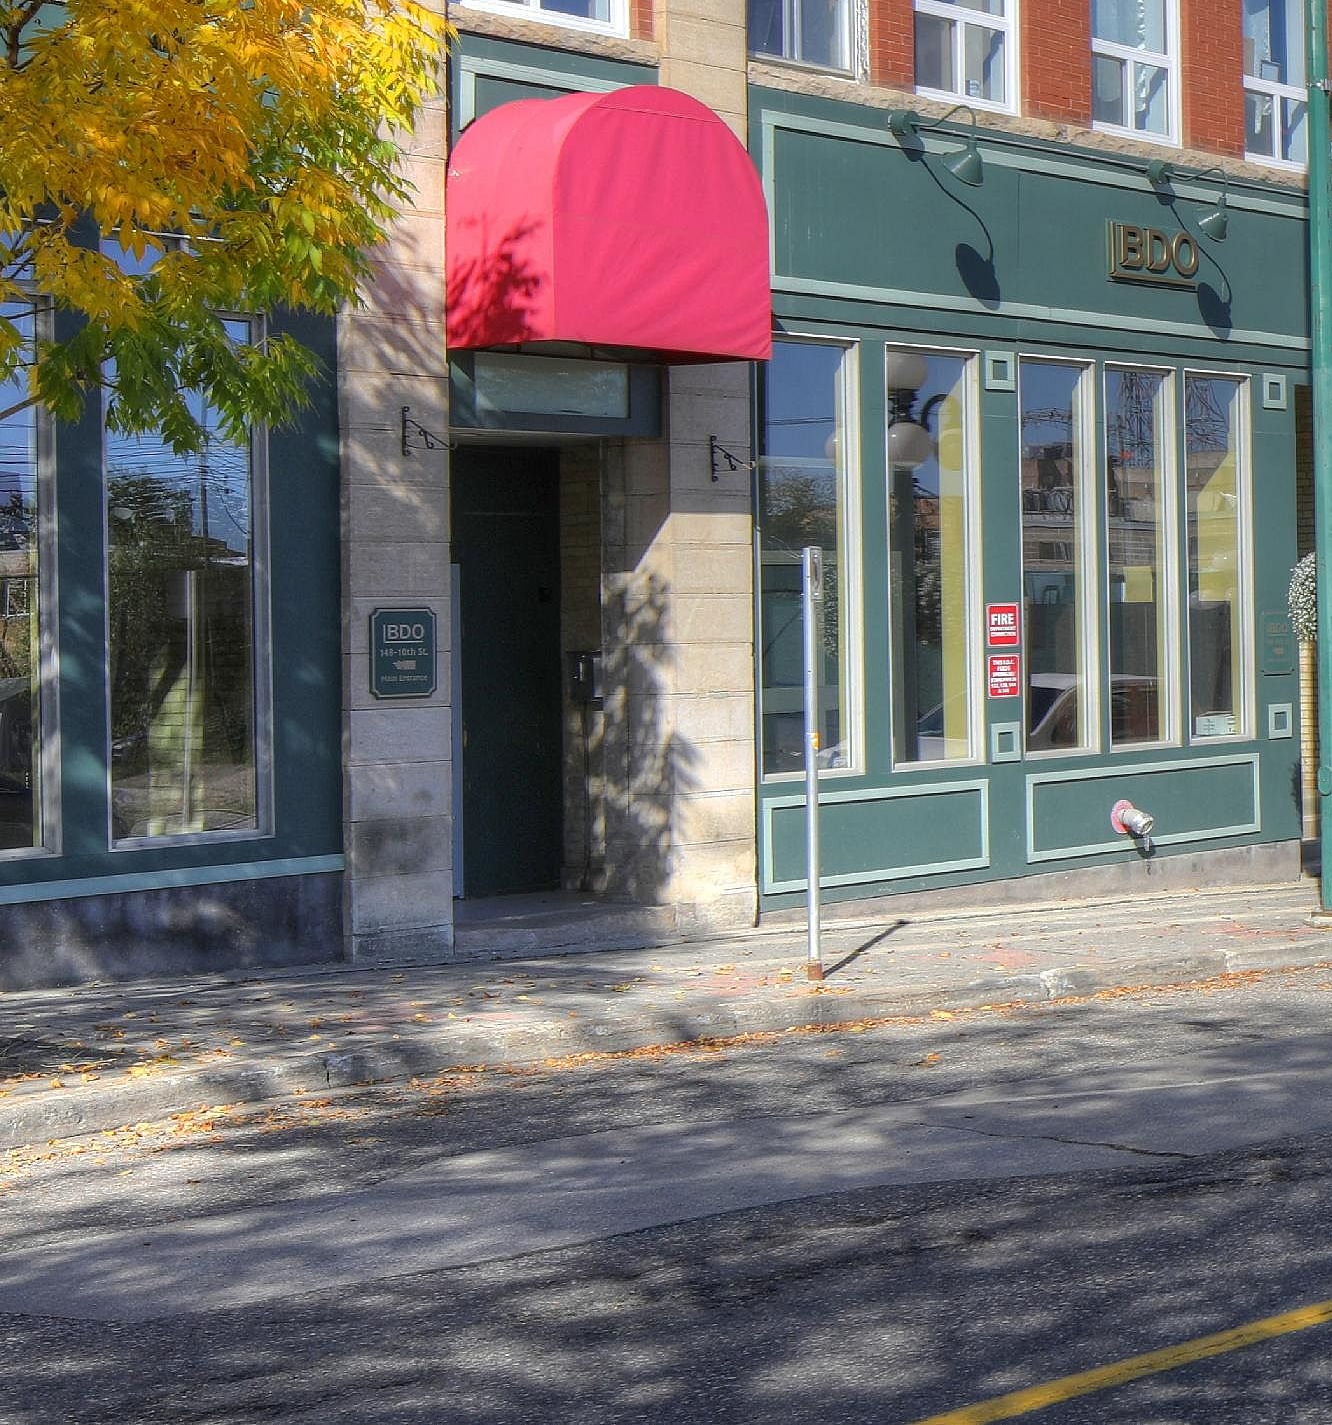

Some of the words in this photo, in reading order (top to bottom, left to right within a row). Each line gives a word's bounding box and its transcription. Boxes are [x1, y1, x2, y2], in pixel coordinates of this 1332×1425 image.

[1119, 224, 1200, 278] BDO
[990, 613, 1015, 626] FIRE
[387, 624, 424, 640] BDO
